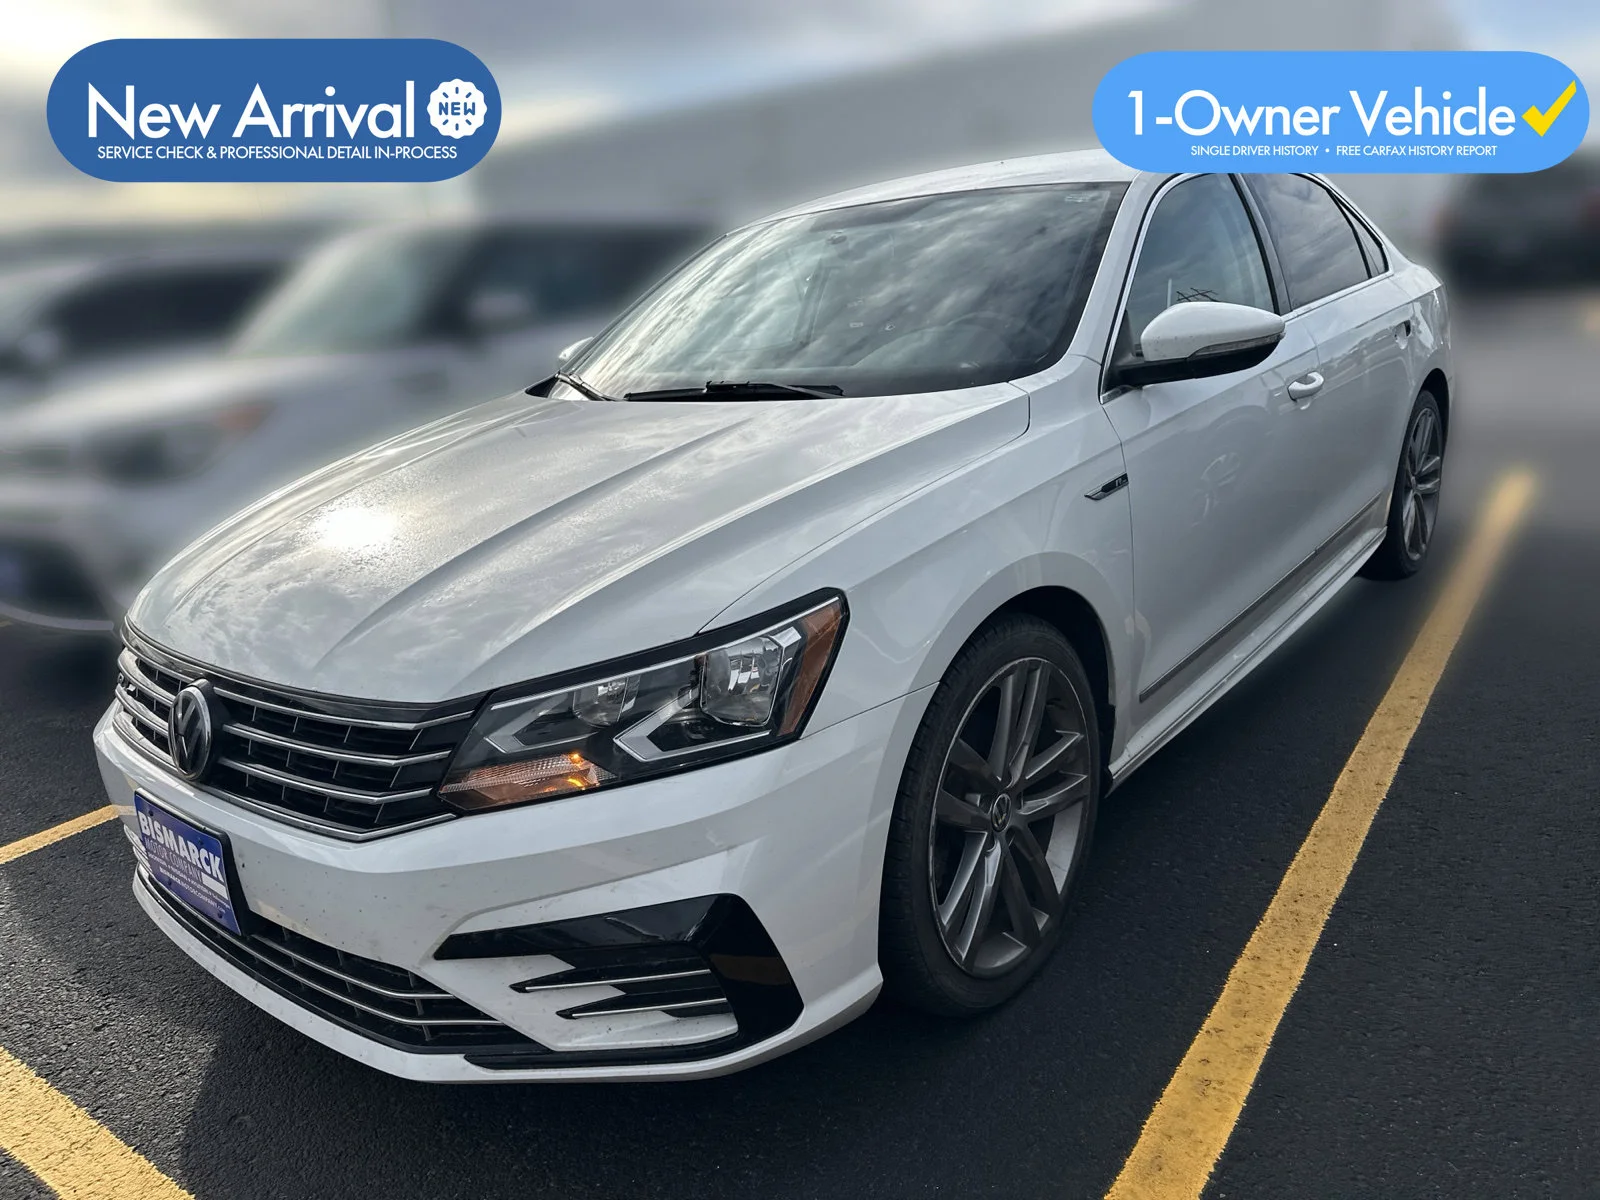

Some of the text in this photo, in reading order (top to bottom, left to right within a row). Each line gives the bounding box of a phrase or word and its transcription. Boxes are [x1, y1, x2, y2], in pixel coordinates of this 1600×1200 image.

[137, 810, 225, 883] BISMARCK
[144, 836, 169, 860] MOTOR
[169, 850, 203, 883] COMPANY
